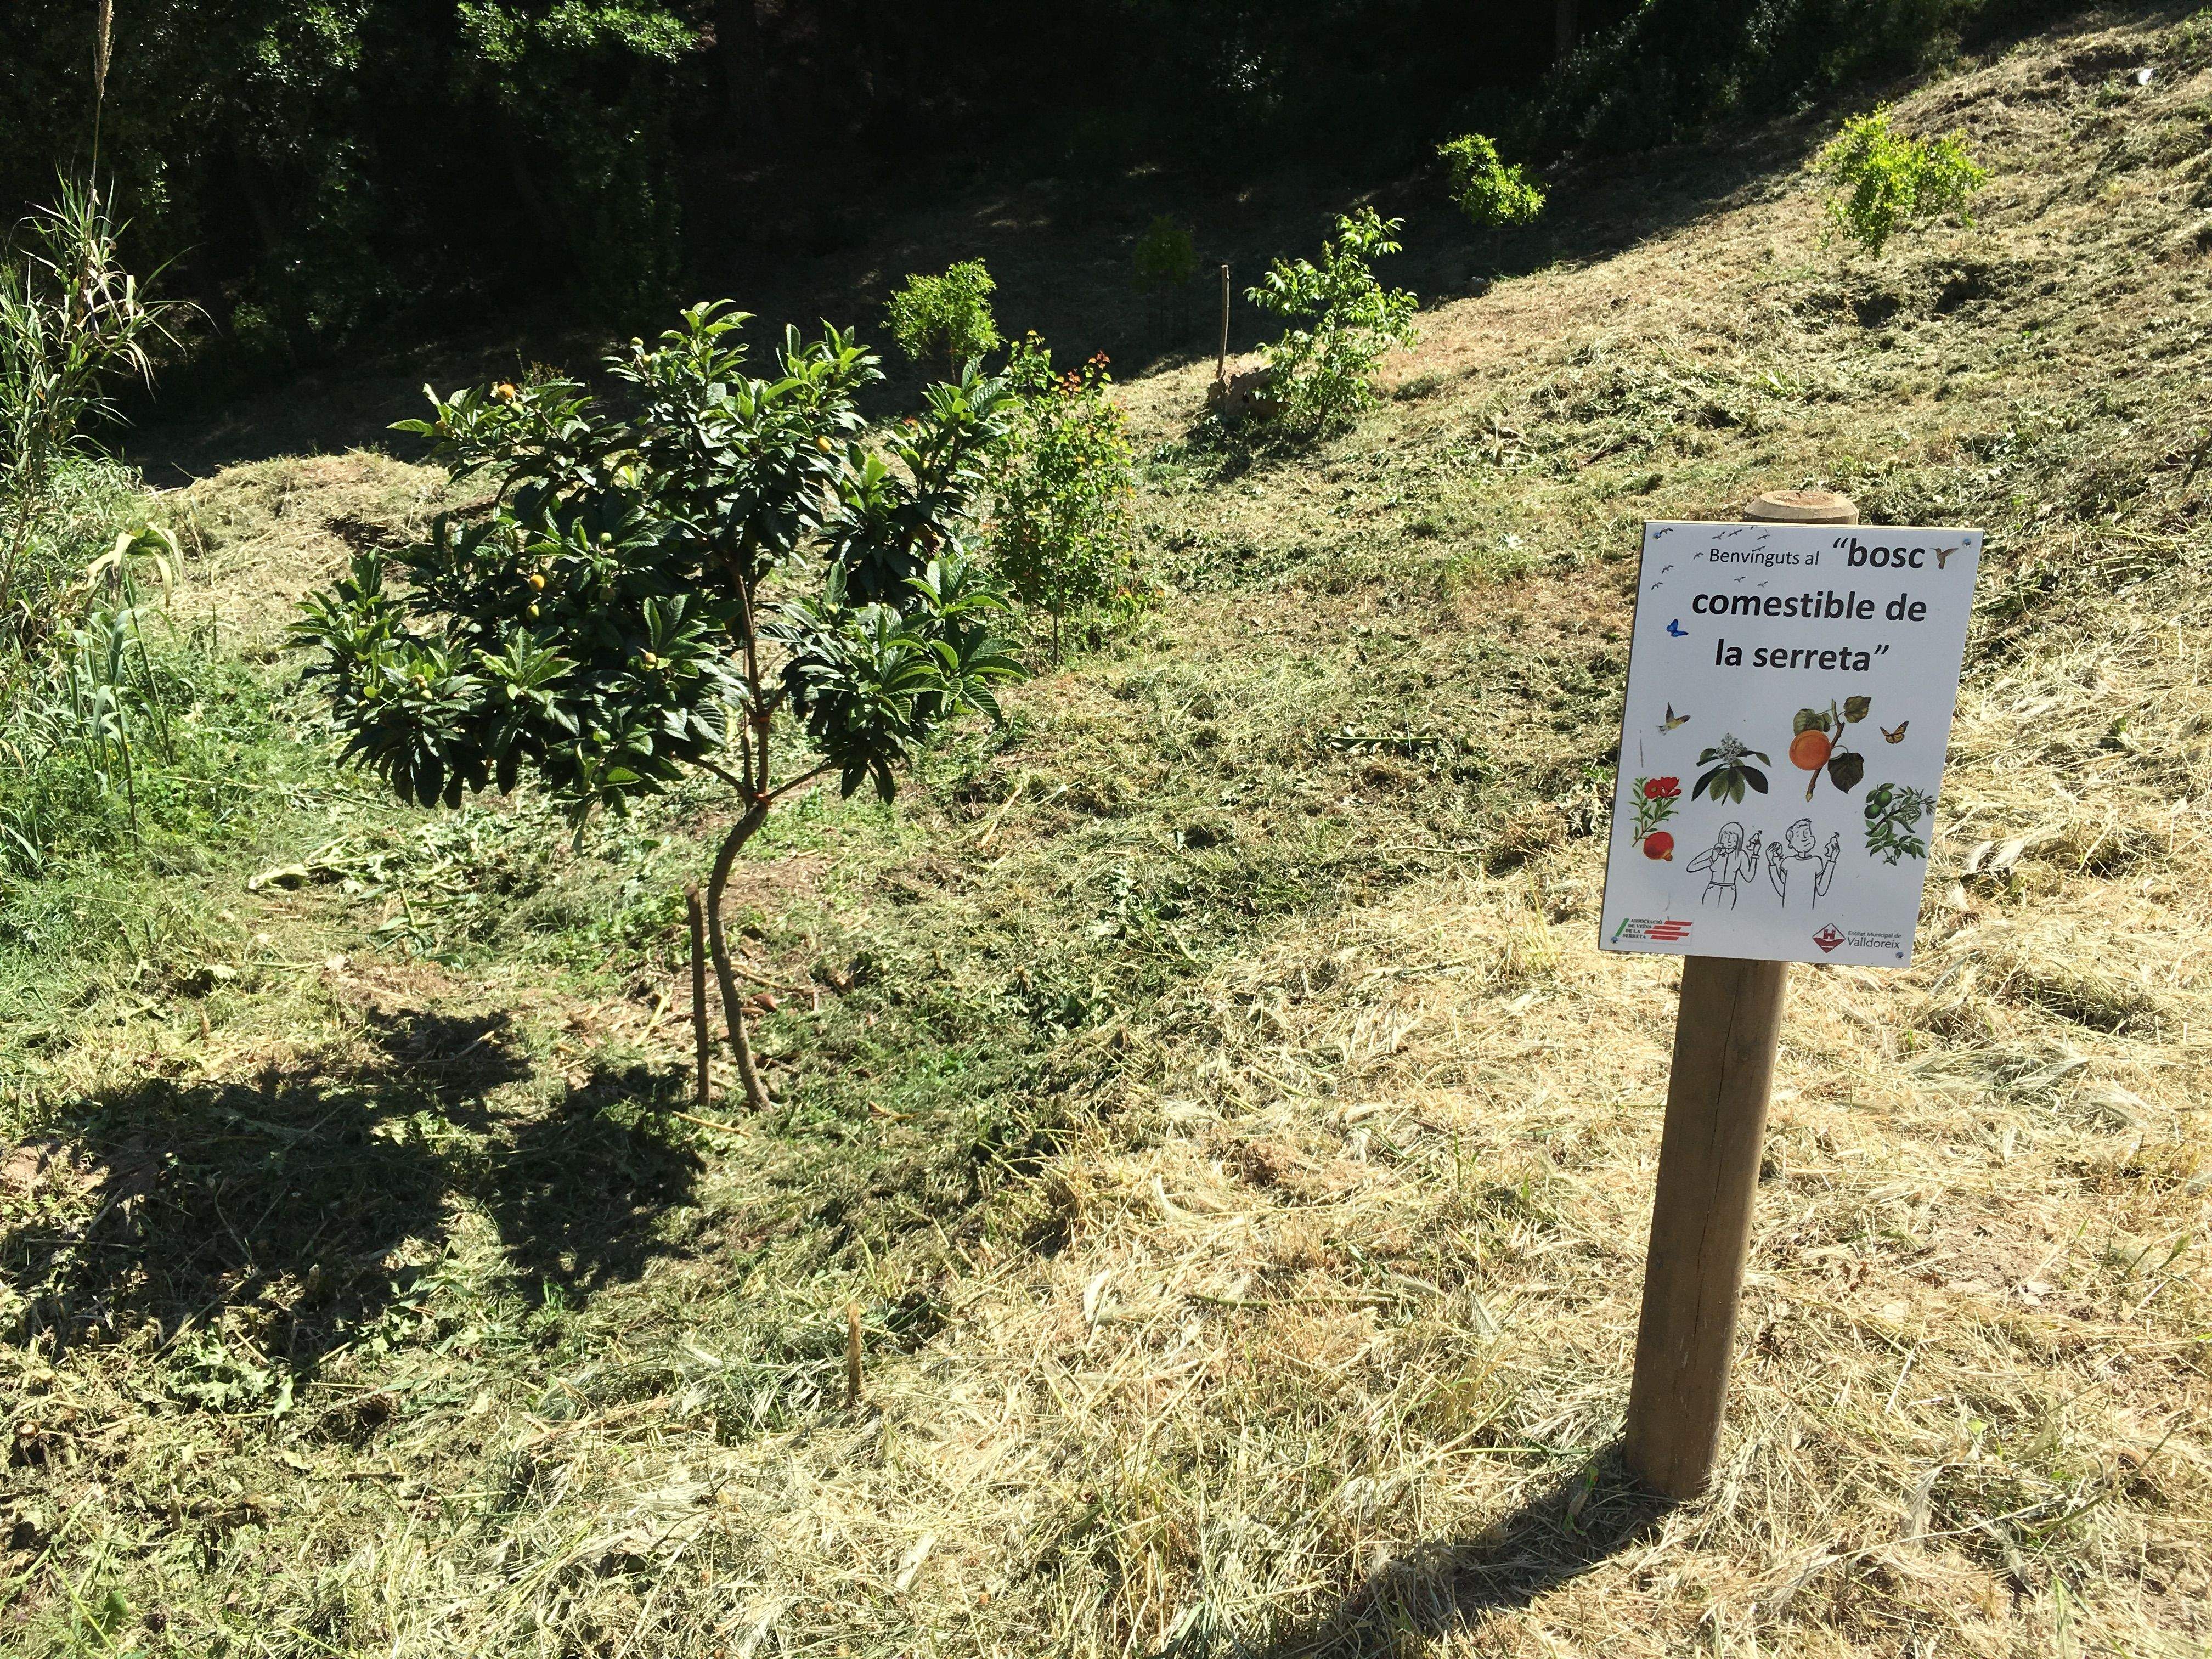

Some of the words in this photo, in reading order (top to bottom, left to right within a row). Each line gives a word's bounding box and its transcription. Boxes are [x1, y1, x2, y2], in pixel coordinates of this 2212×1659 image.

[1709, 548, 1800, 567] Benvinguts
[1805, 550, 1820, 565] al
[1833, 537, 1925, 568] “bosc
[1692, 590, 1875, 620] comestible
[1886, 593, 1927, 622] de
[1715, 638, 1743, 667] la
[1753, 644, 1889, 672] serreta”
[1847, 936, 1900, 949] Valldoreix
